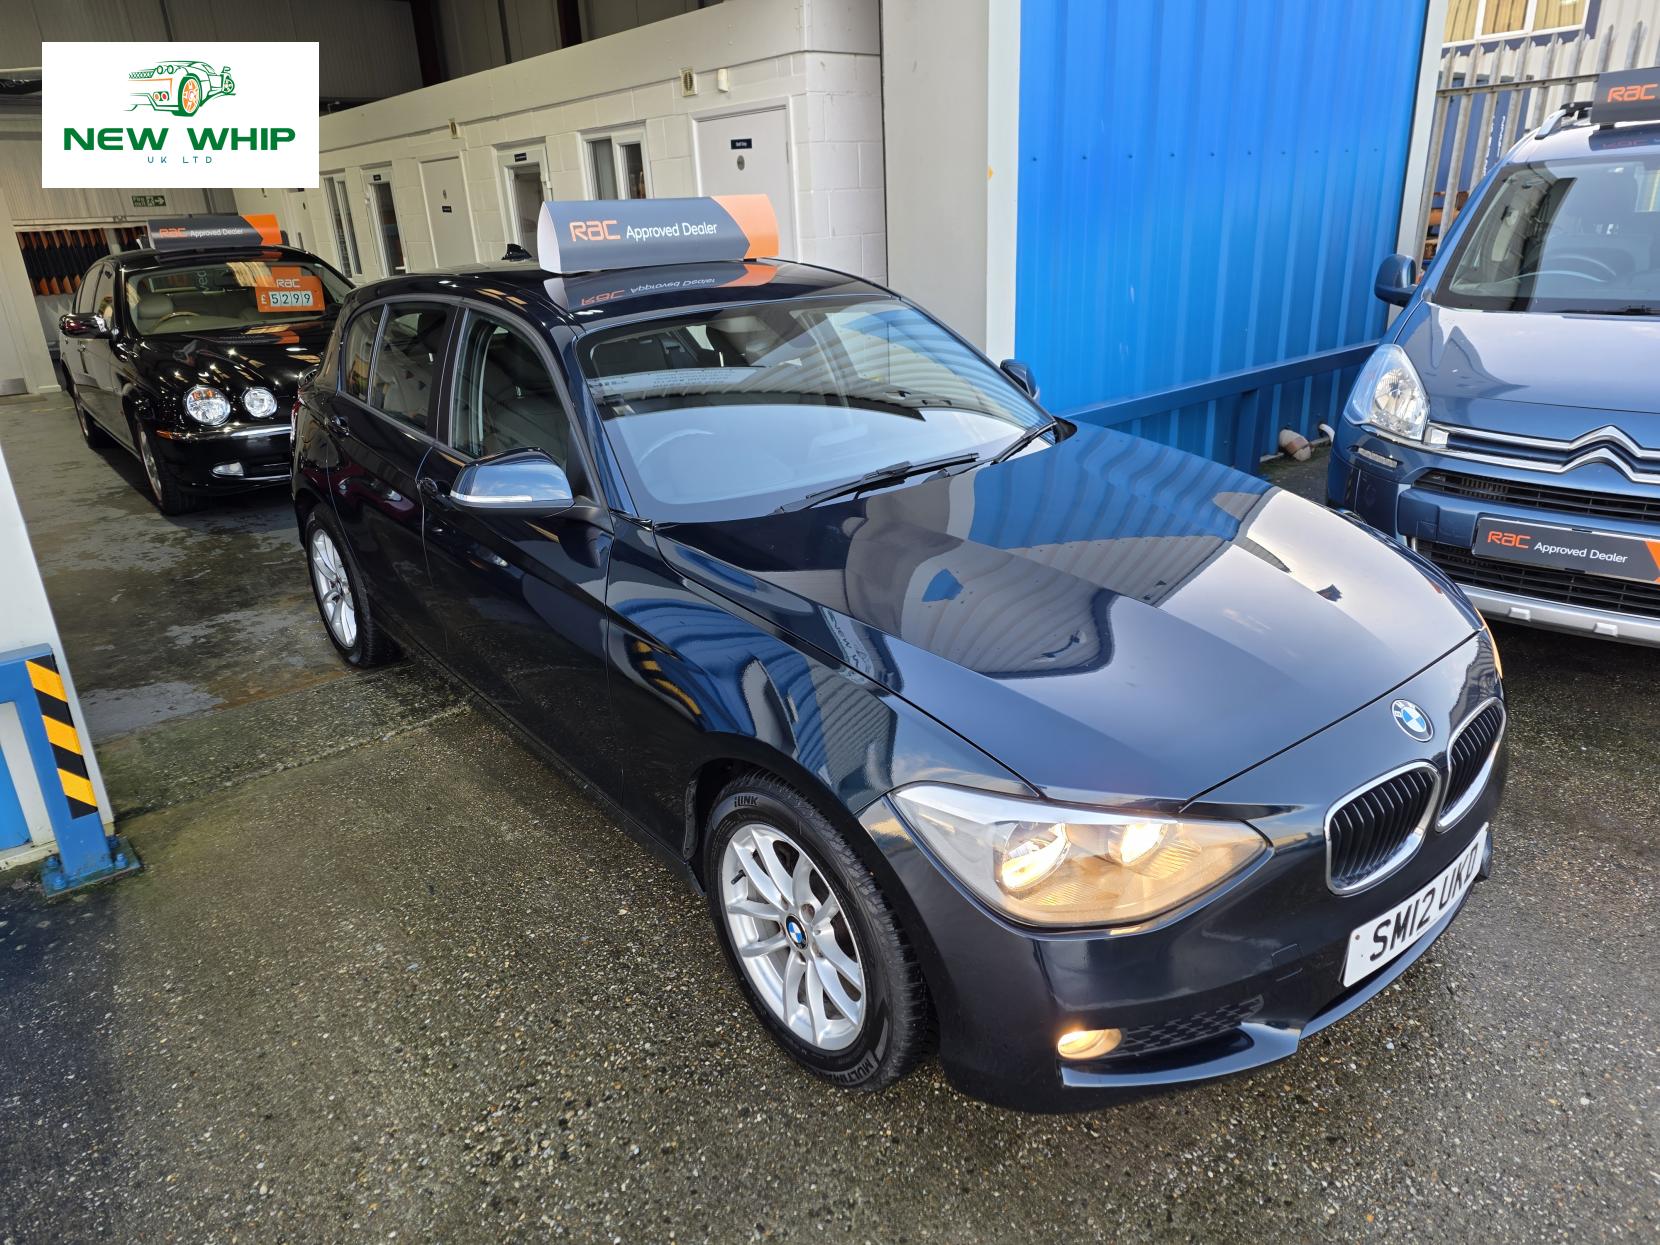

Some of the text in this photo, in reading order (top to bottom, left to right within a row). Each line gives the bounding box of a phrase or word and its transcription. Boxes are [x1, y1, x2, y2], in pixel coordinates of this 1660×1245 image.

[190, 228, 222, 238] Approved
[626, 222, 680, 242] Approved
[682, 221, 718, 236] Dealer
[1534, 542, 1587, 558] Approved
[1589, 549, 1628, 564] Dealer
[1369, 887, 1436, 962] SM12
